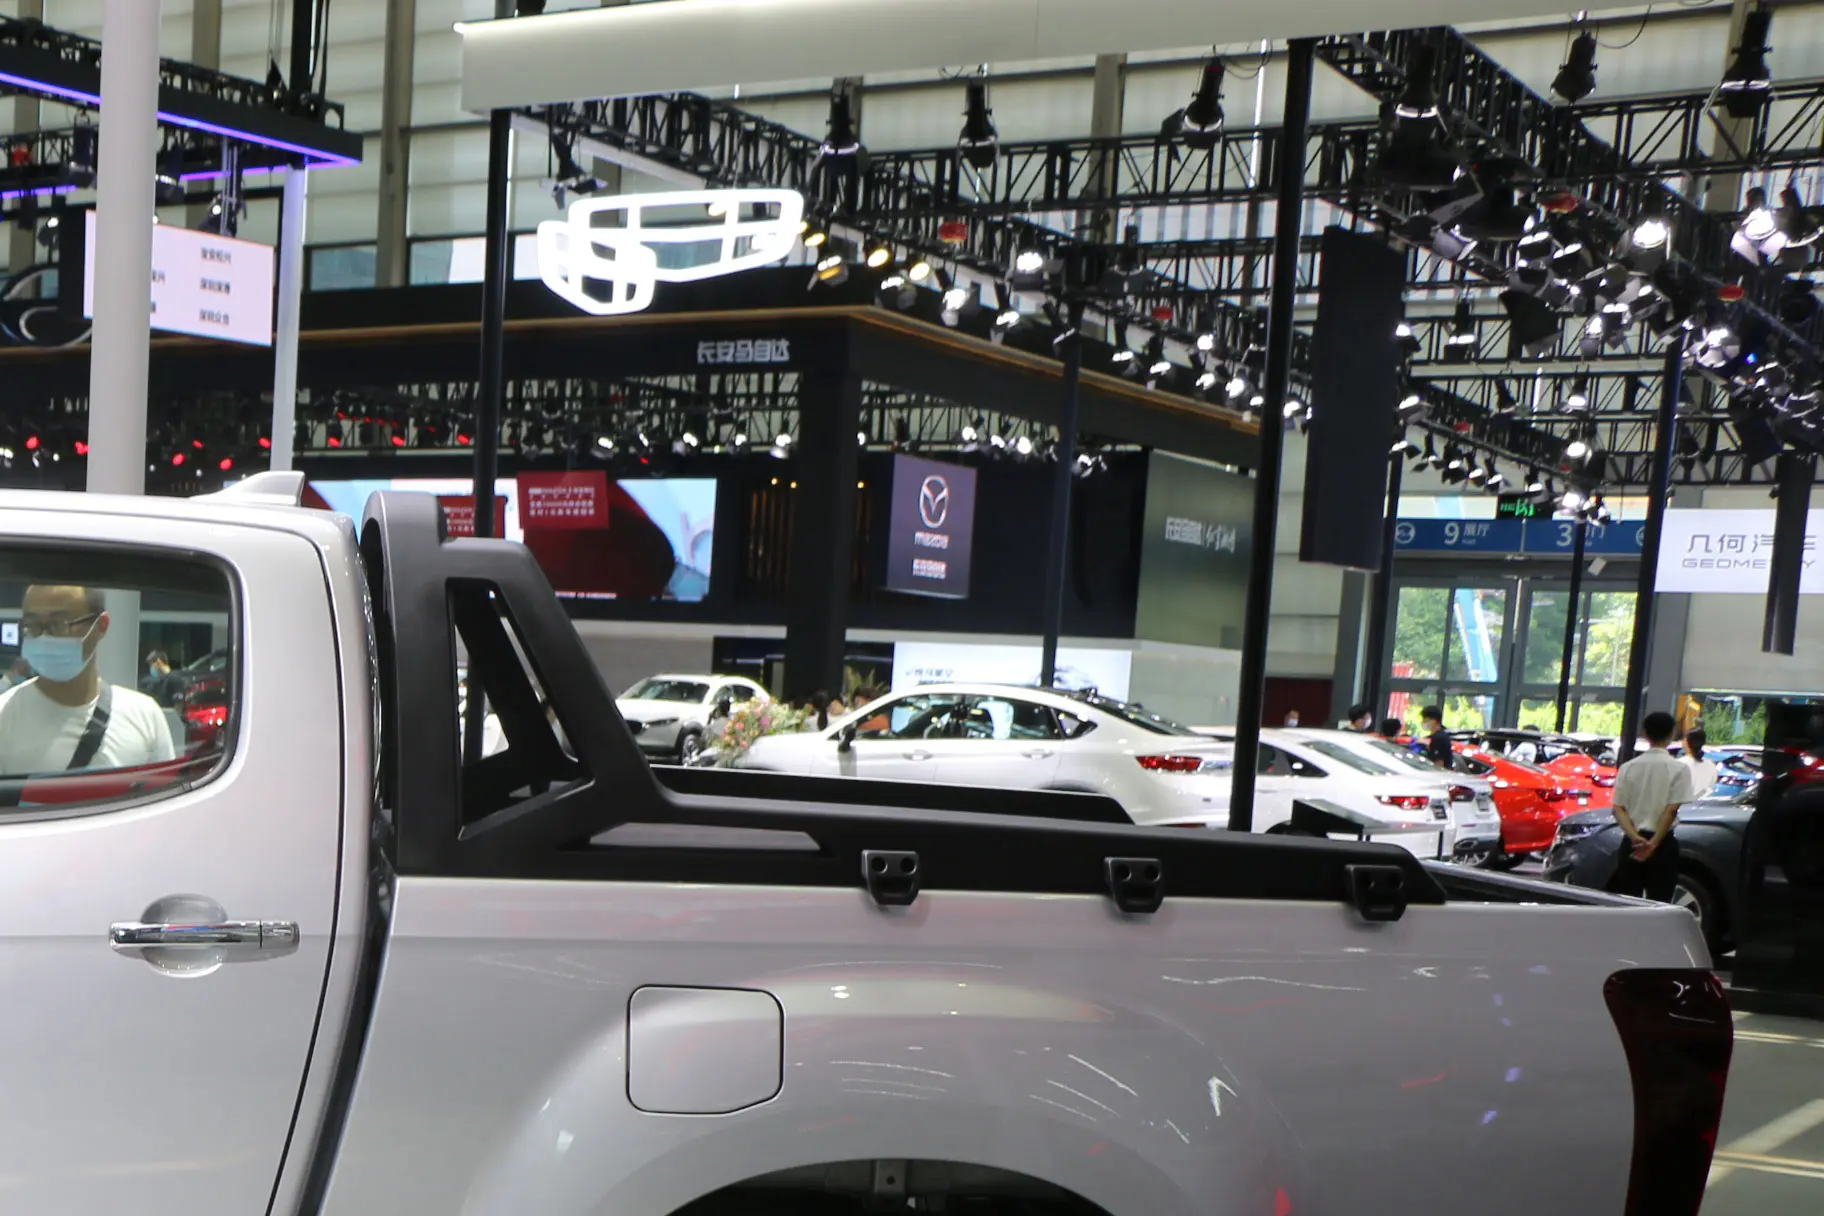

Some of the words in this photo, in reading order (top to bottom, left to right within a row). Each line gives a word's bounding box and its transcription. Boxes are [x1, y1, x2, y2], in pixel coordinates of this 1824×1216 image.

[697, 339, 790, 364] 长安马自达
[1444, 522, 1459, 545] 9
[1556, 523, 1572, 546] 3
[1682, 558, 1816, 569] GEOMEY
